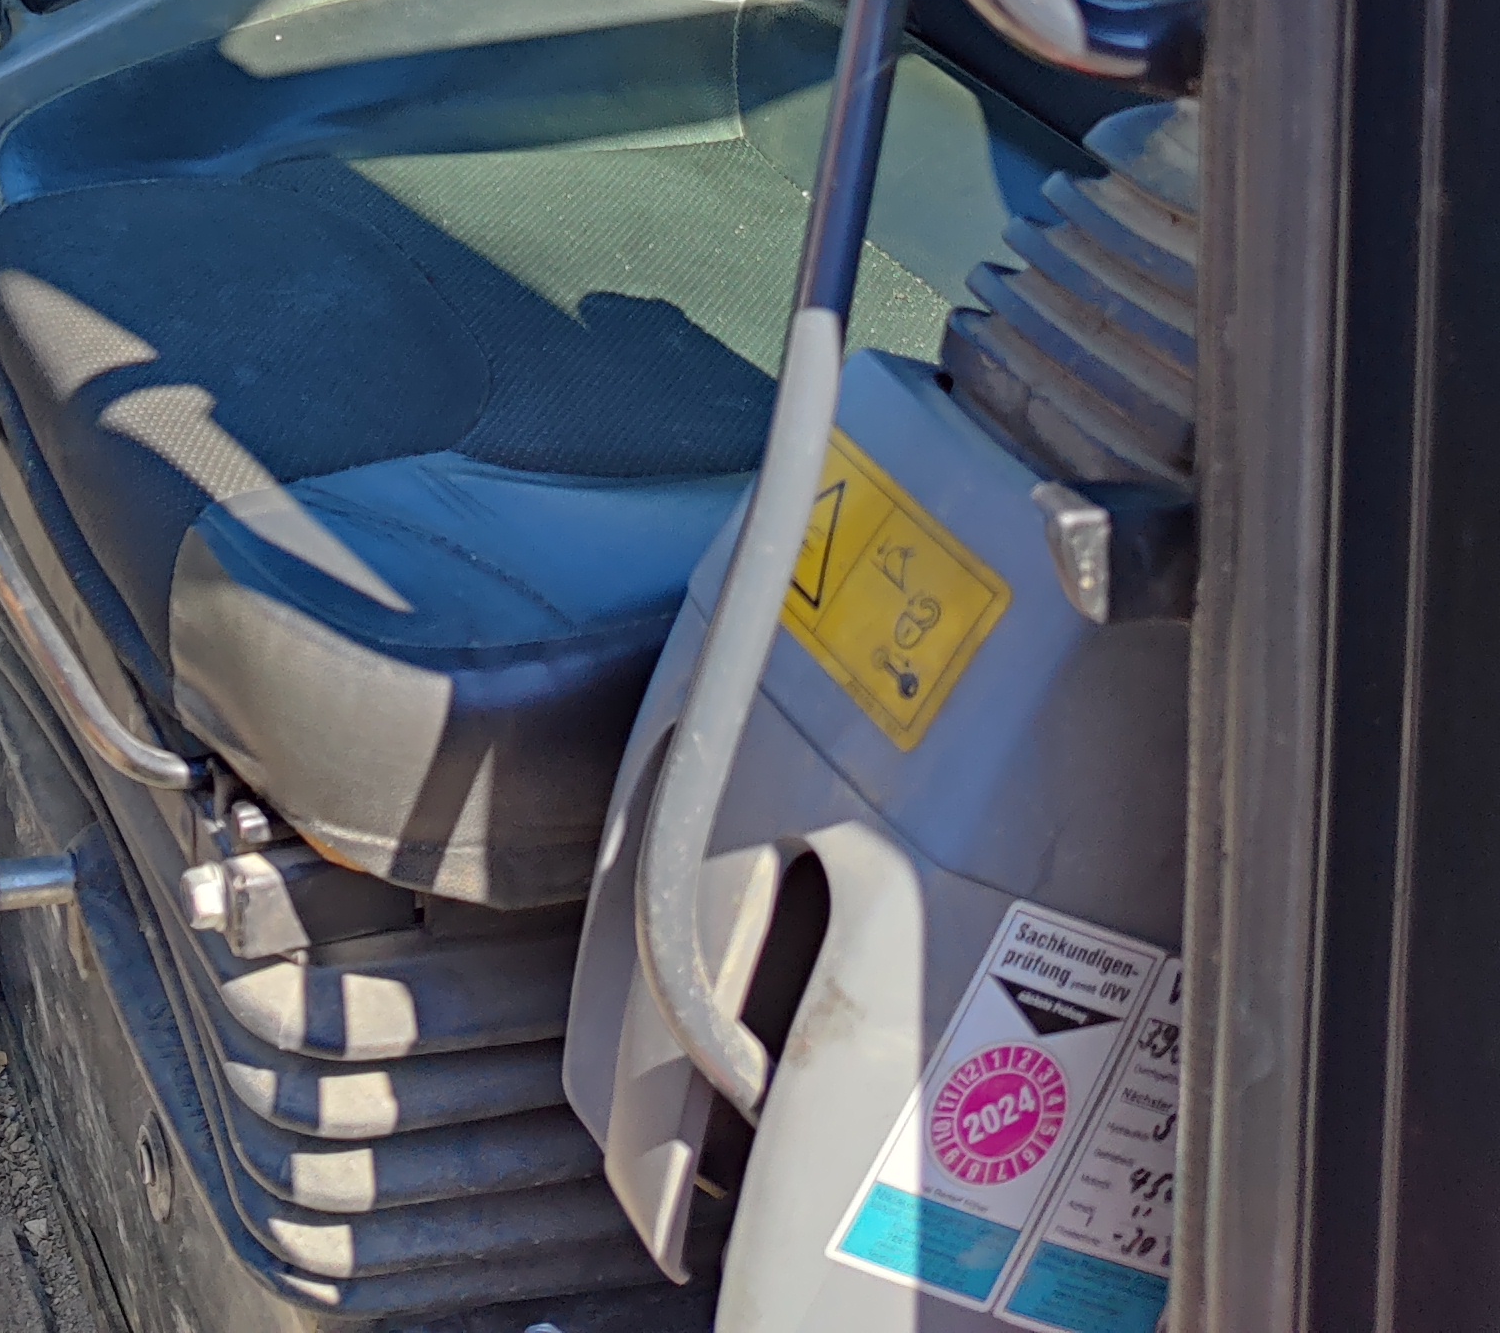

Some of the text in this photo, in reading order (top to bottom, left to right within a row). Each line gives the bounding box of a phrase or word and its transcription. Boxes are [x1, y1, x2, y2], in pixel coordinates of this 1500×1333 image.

[1015, 921, 1139, 978] Sachkundigen-
[1002, 949, 1072, 989] prüfung
[1100, 980, 1131, 1003] UVV
[956, 1063, 981, 1085] 12
[992, 1051, 1000, 1067] 1
[1018, 1050, 1032, 1069] 2
[962, 1084, 1036, 1145] 2024
